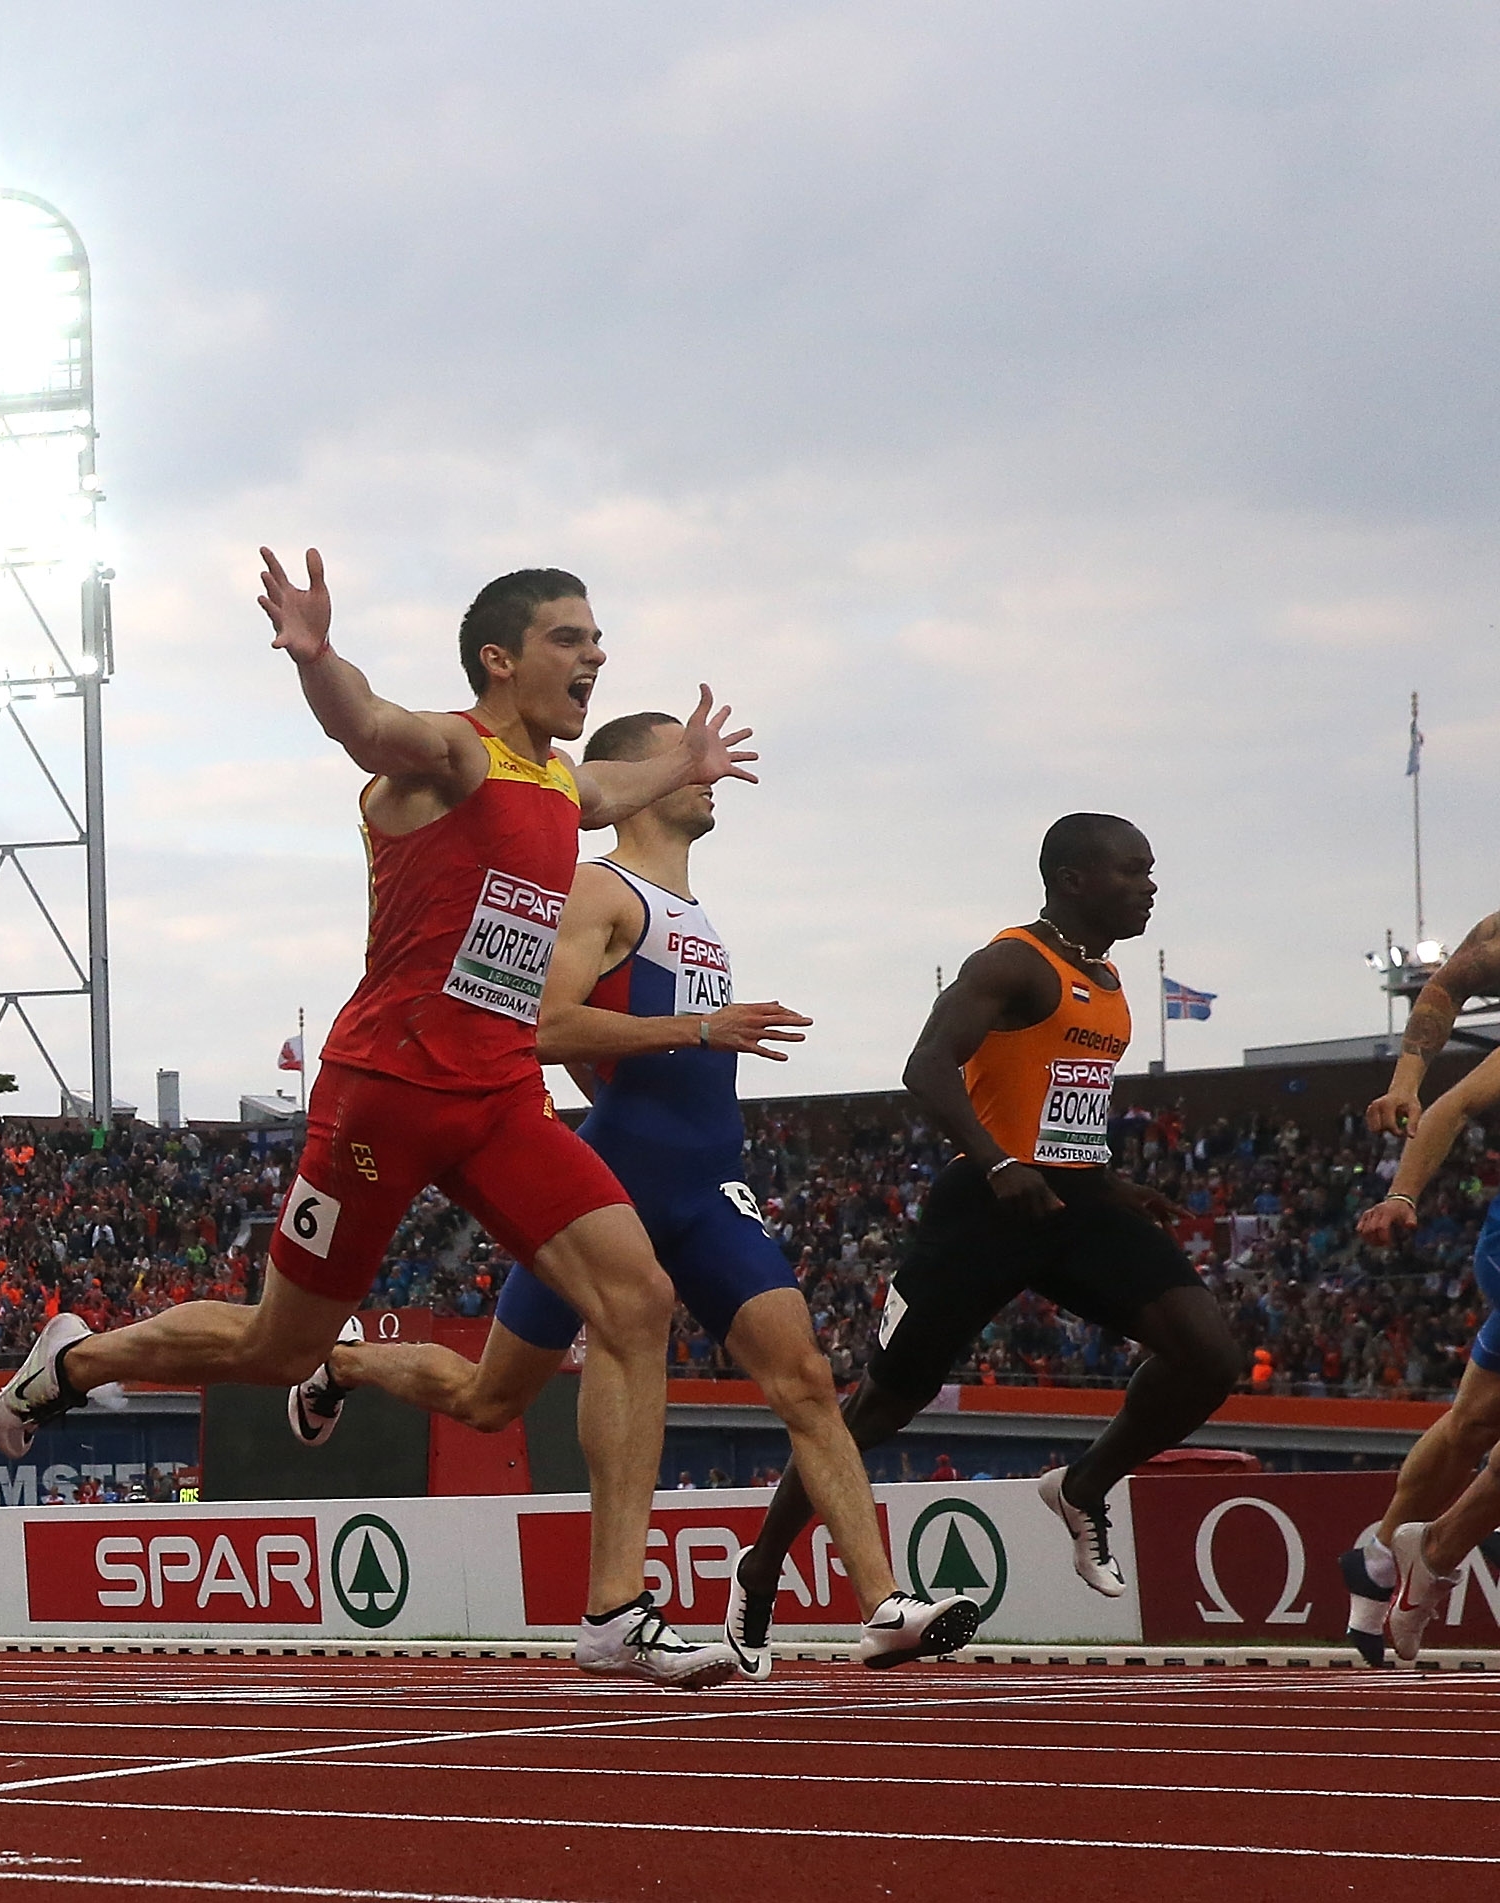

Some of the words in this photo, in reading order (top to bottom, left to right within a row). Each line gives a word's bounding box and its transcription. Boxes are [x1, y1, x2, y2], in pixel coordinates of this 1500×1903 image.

[487, 879, 563, 923] SPAR
[684, 940, 726, 967] SPAR
[448, 976, 528, 1014] AMSTERDAM
[511, 977, 538, 994] CLEAN
[1055, 1065, 1111, 1085] SPAR
[1047, 1091, 1111, 1126] BOCKA
[350, 1142, 378, 1181] ESP
[293, 1196, 321, 1240] 6
[95, 1534, 315, 1609] SPAR
